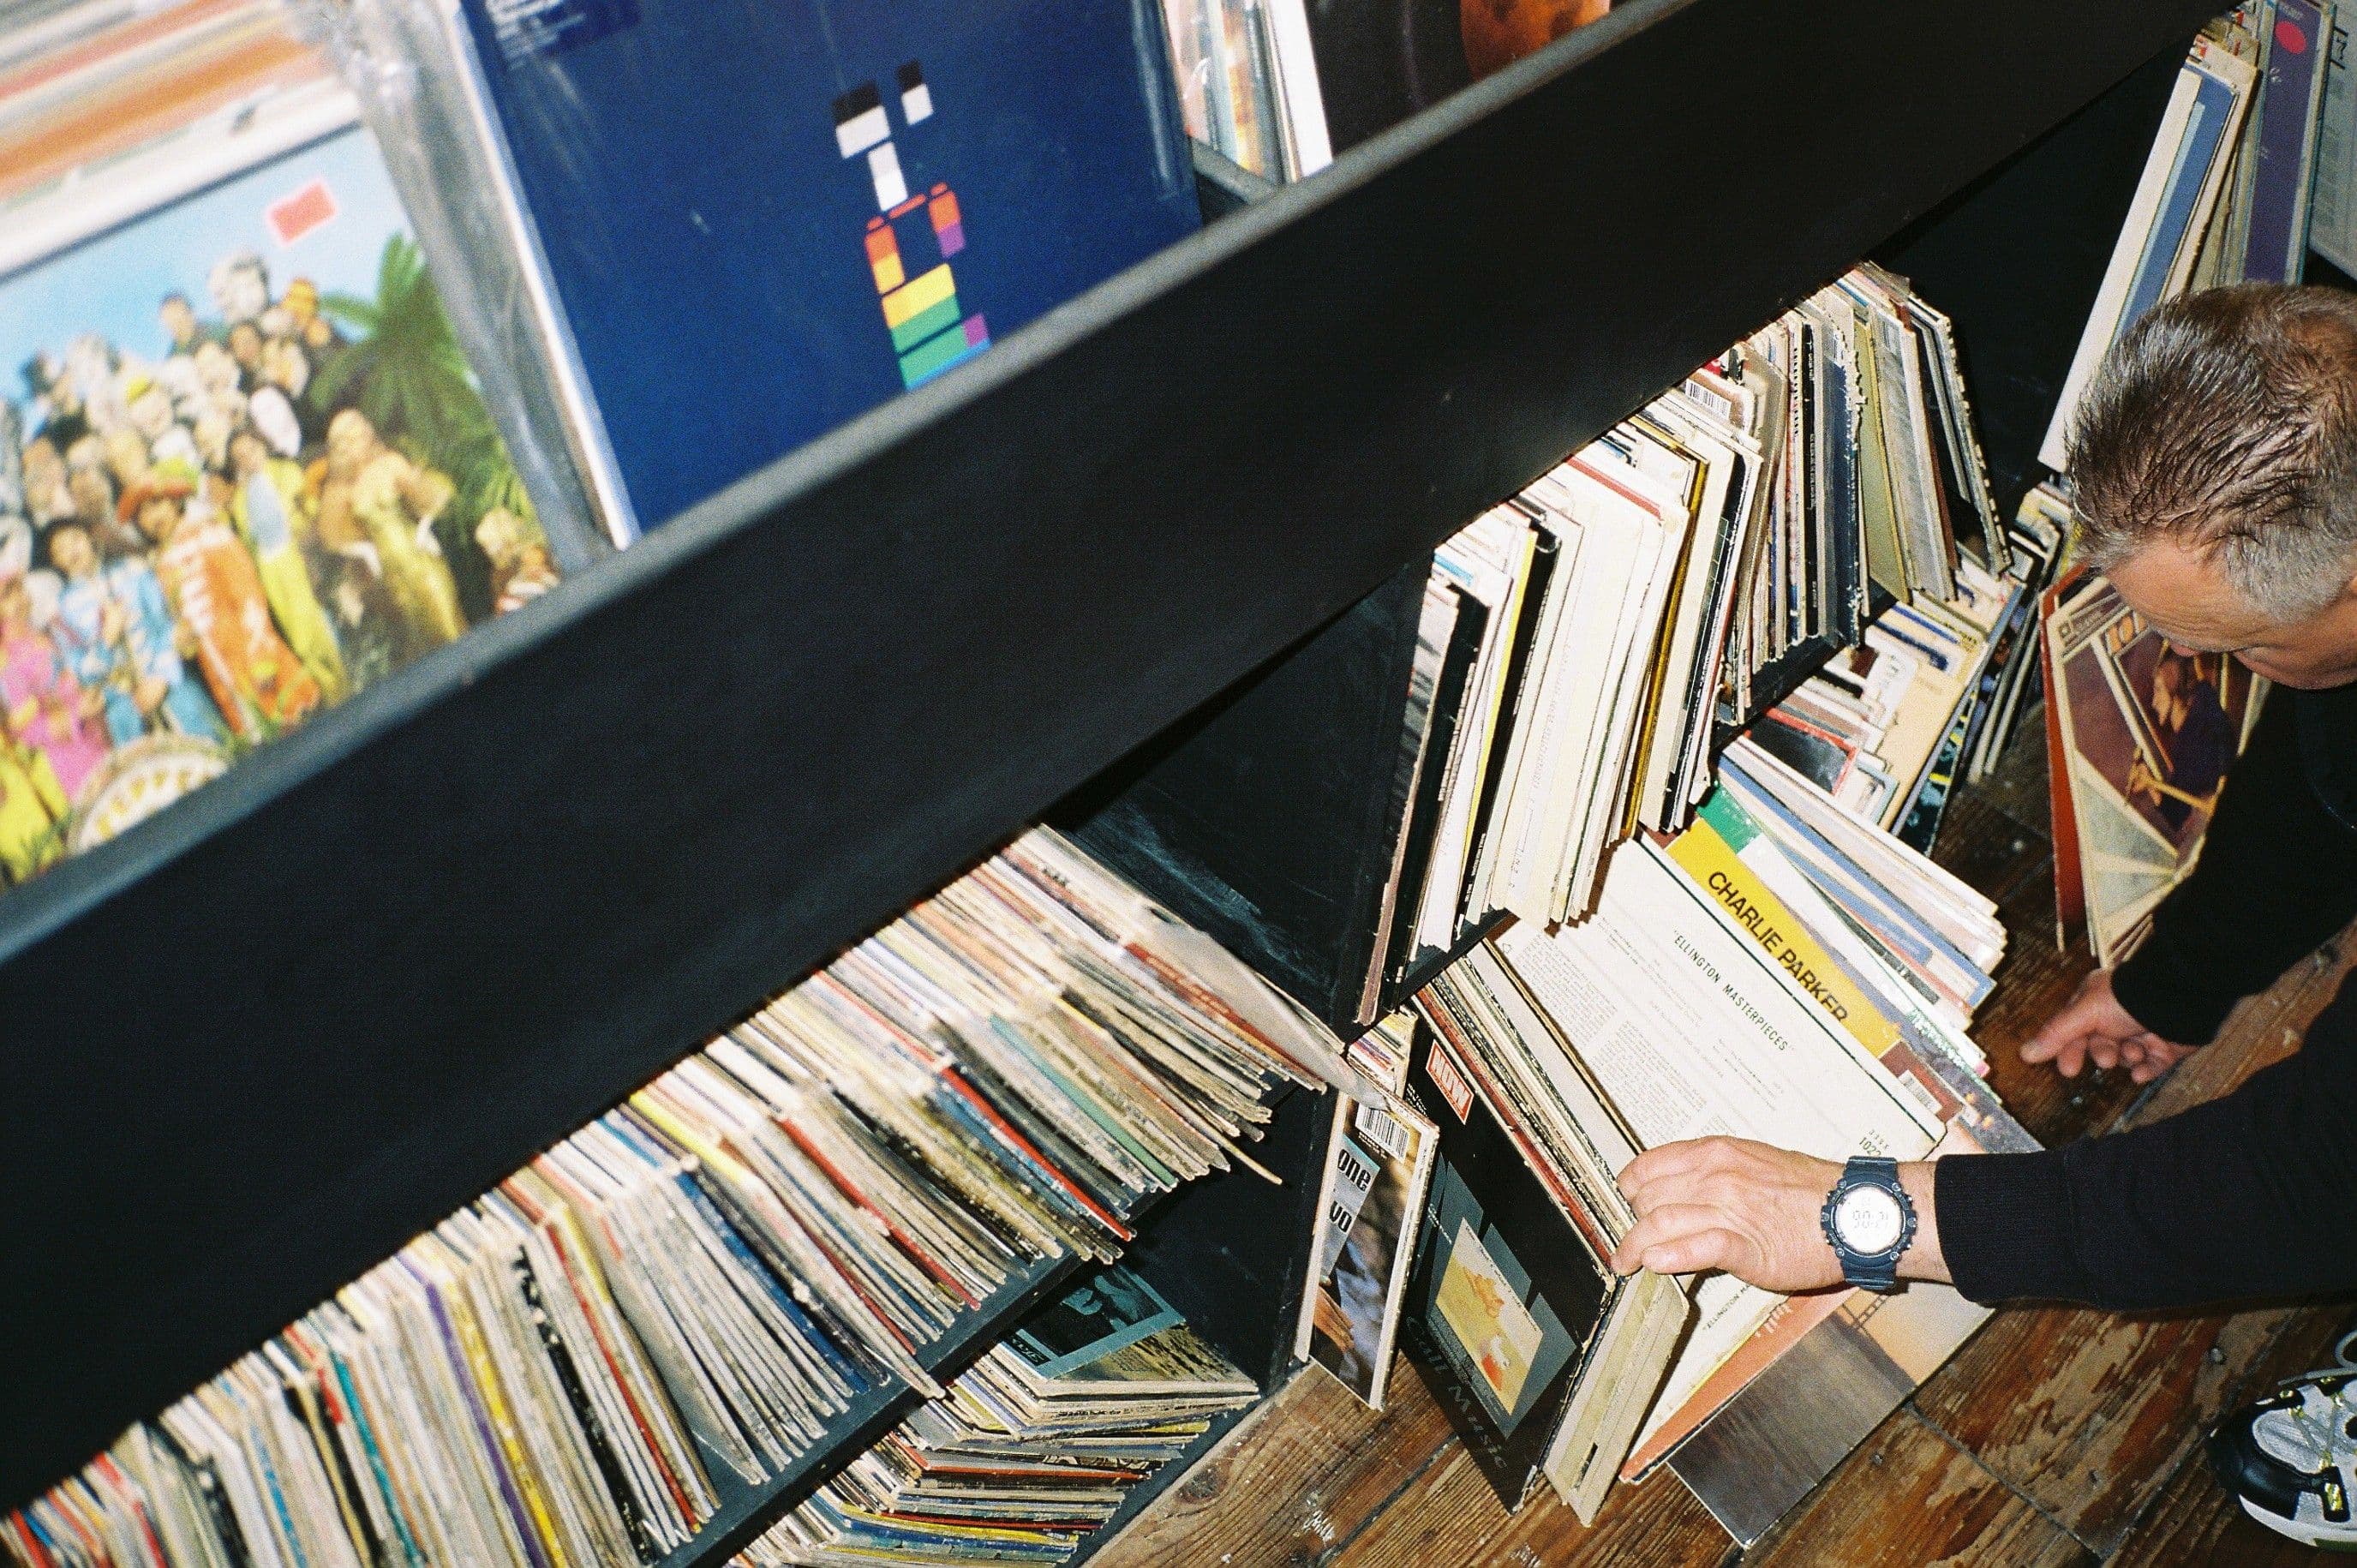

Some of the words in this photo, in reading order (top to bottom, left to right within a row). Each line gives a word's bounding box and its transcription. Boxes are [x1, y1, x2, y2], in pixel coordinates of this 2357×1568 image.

[1708, 871, 1784, 954] CHARLIE
[1778, 948, 1848, 1022] PARKER
[1432, 1047, 1471, 1110] NOW
